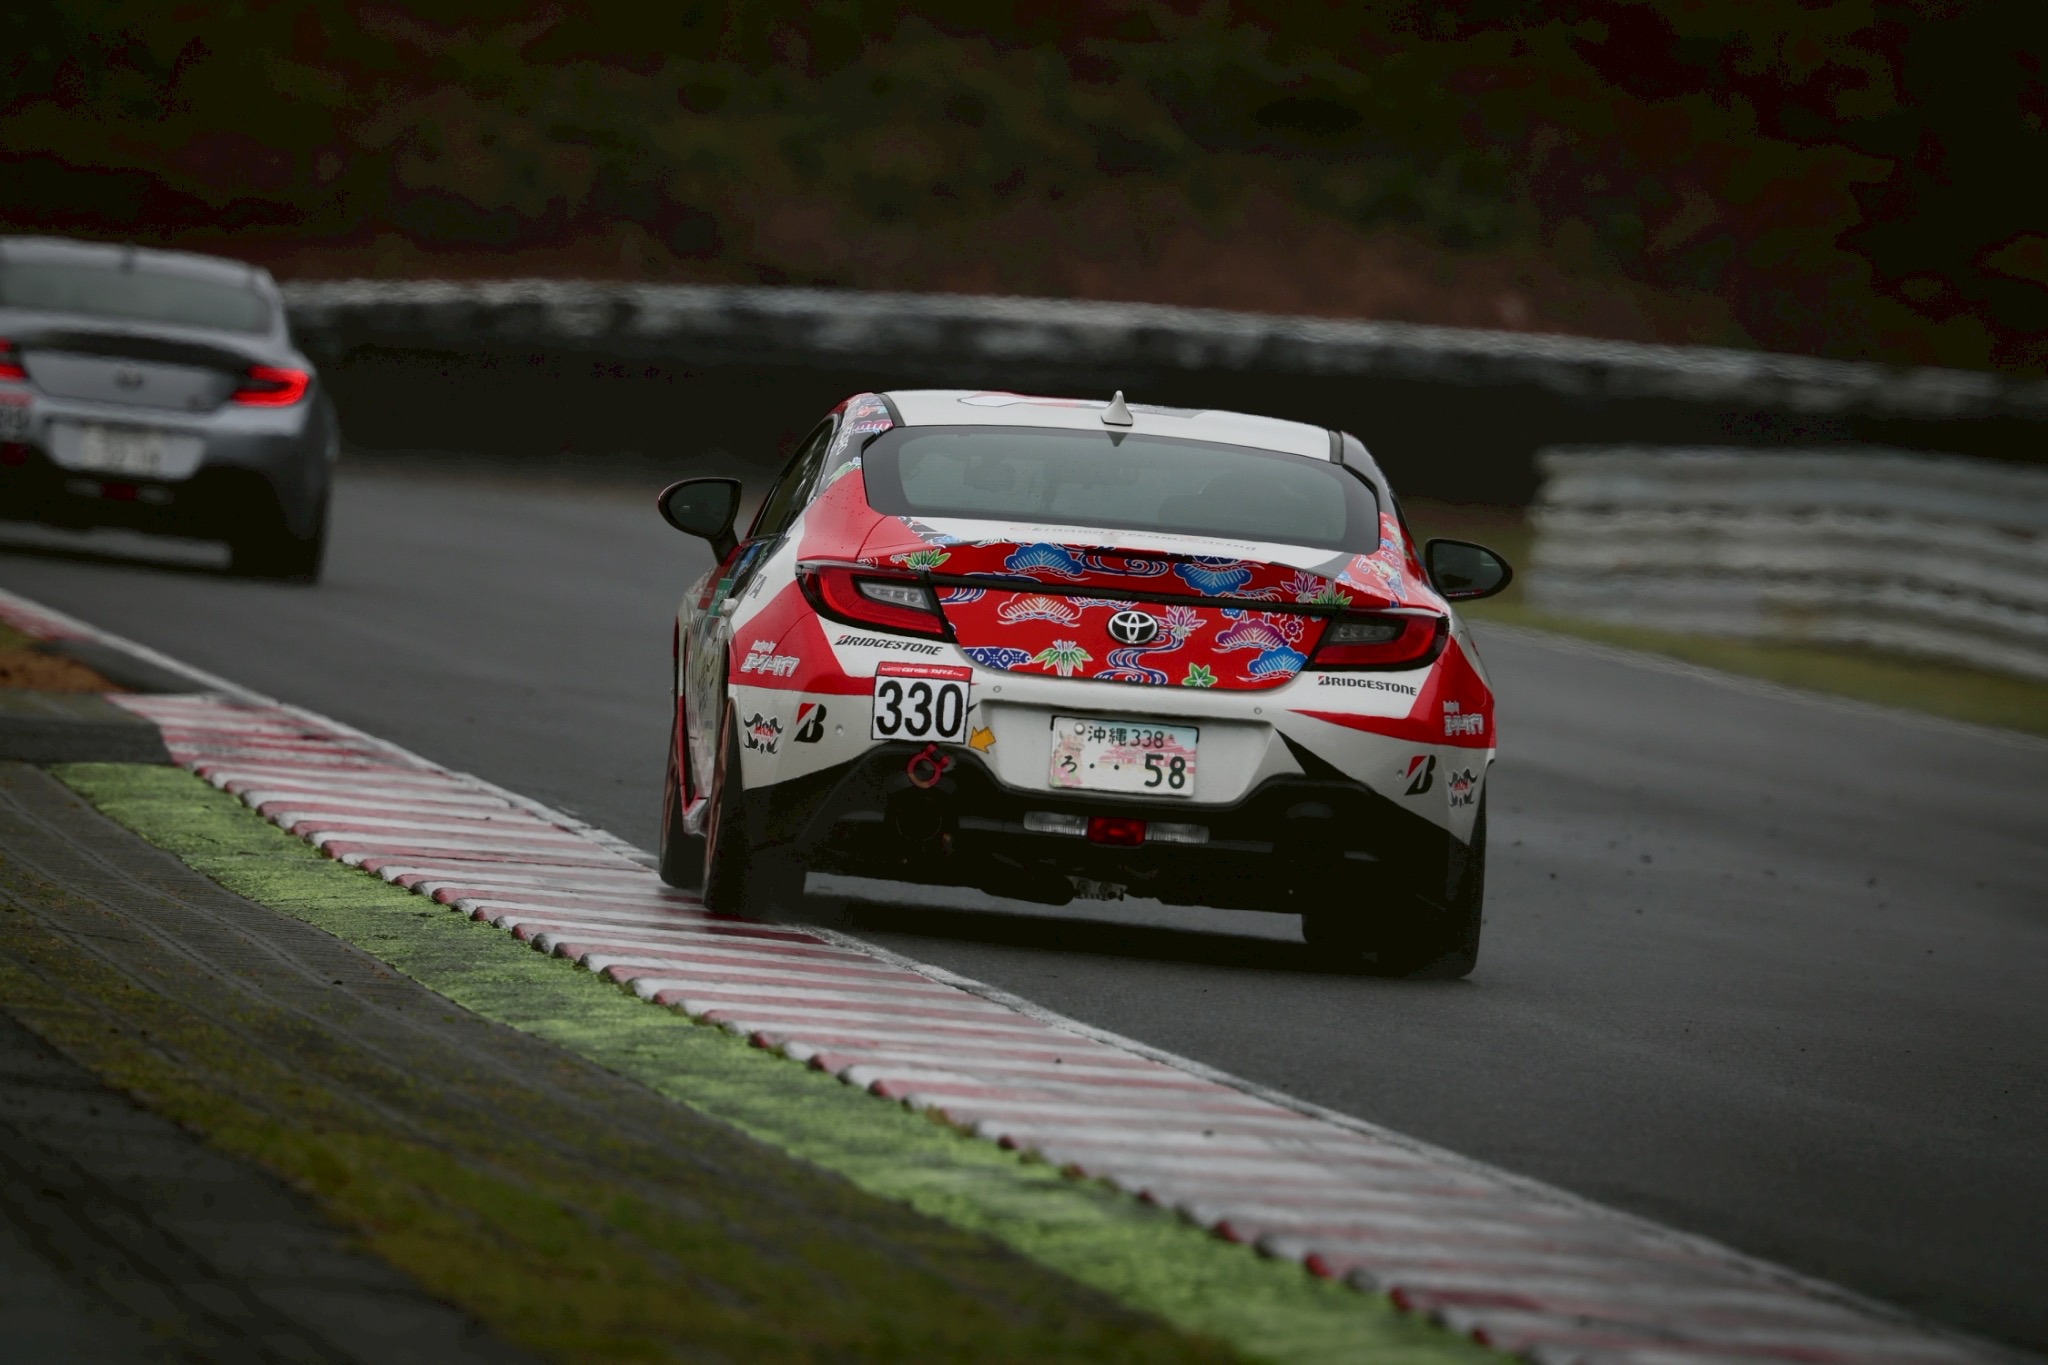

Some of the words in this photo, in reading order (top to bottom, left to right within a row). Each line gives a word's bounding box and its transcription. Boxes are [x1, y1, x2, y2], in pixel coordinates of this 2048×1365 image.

[834, 634, 944, 656] BRIDGESTONE
[1317, 675, 1418, 697] BRIDGESTONE
[876, 680, 964, 739] 330
[1129, 729, 1165, 749] 338
[1060, 754, 1078, 774] ろ
